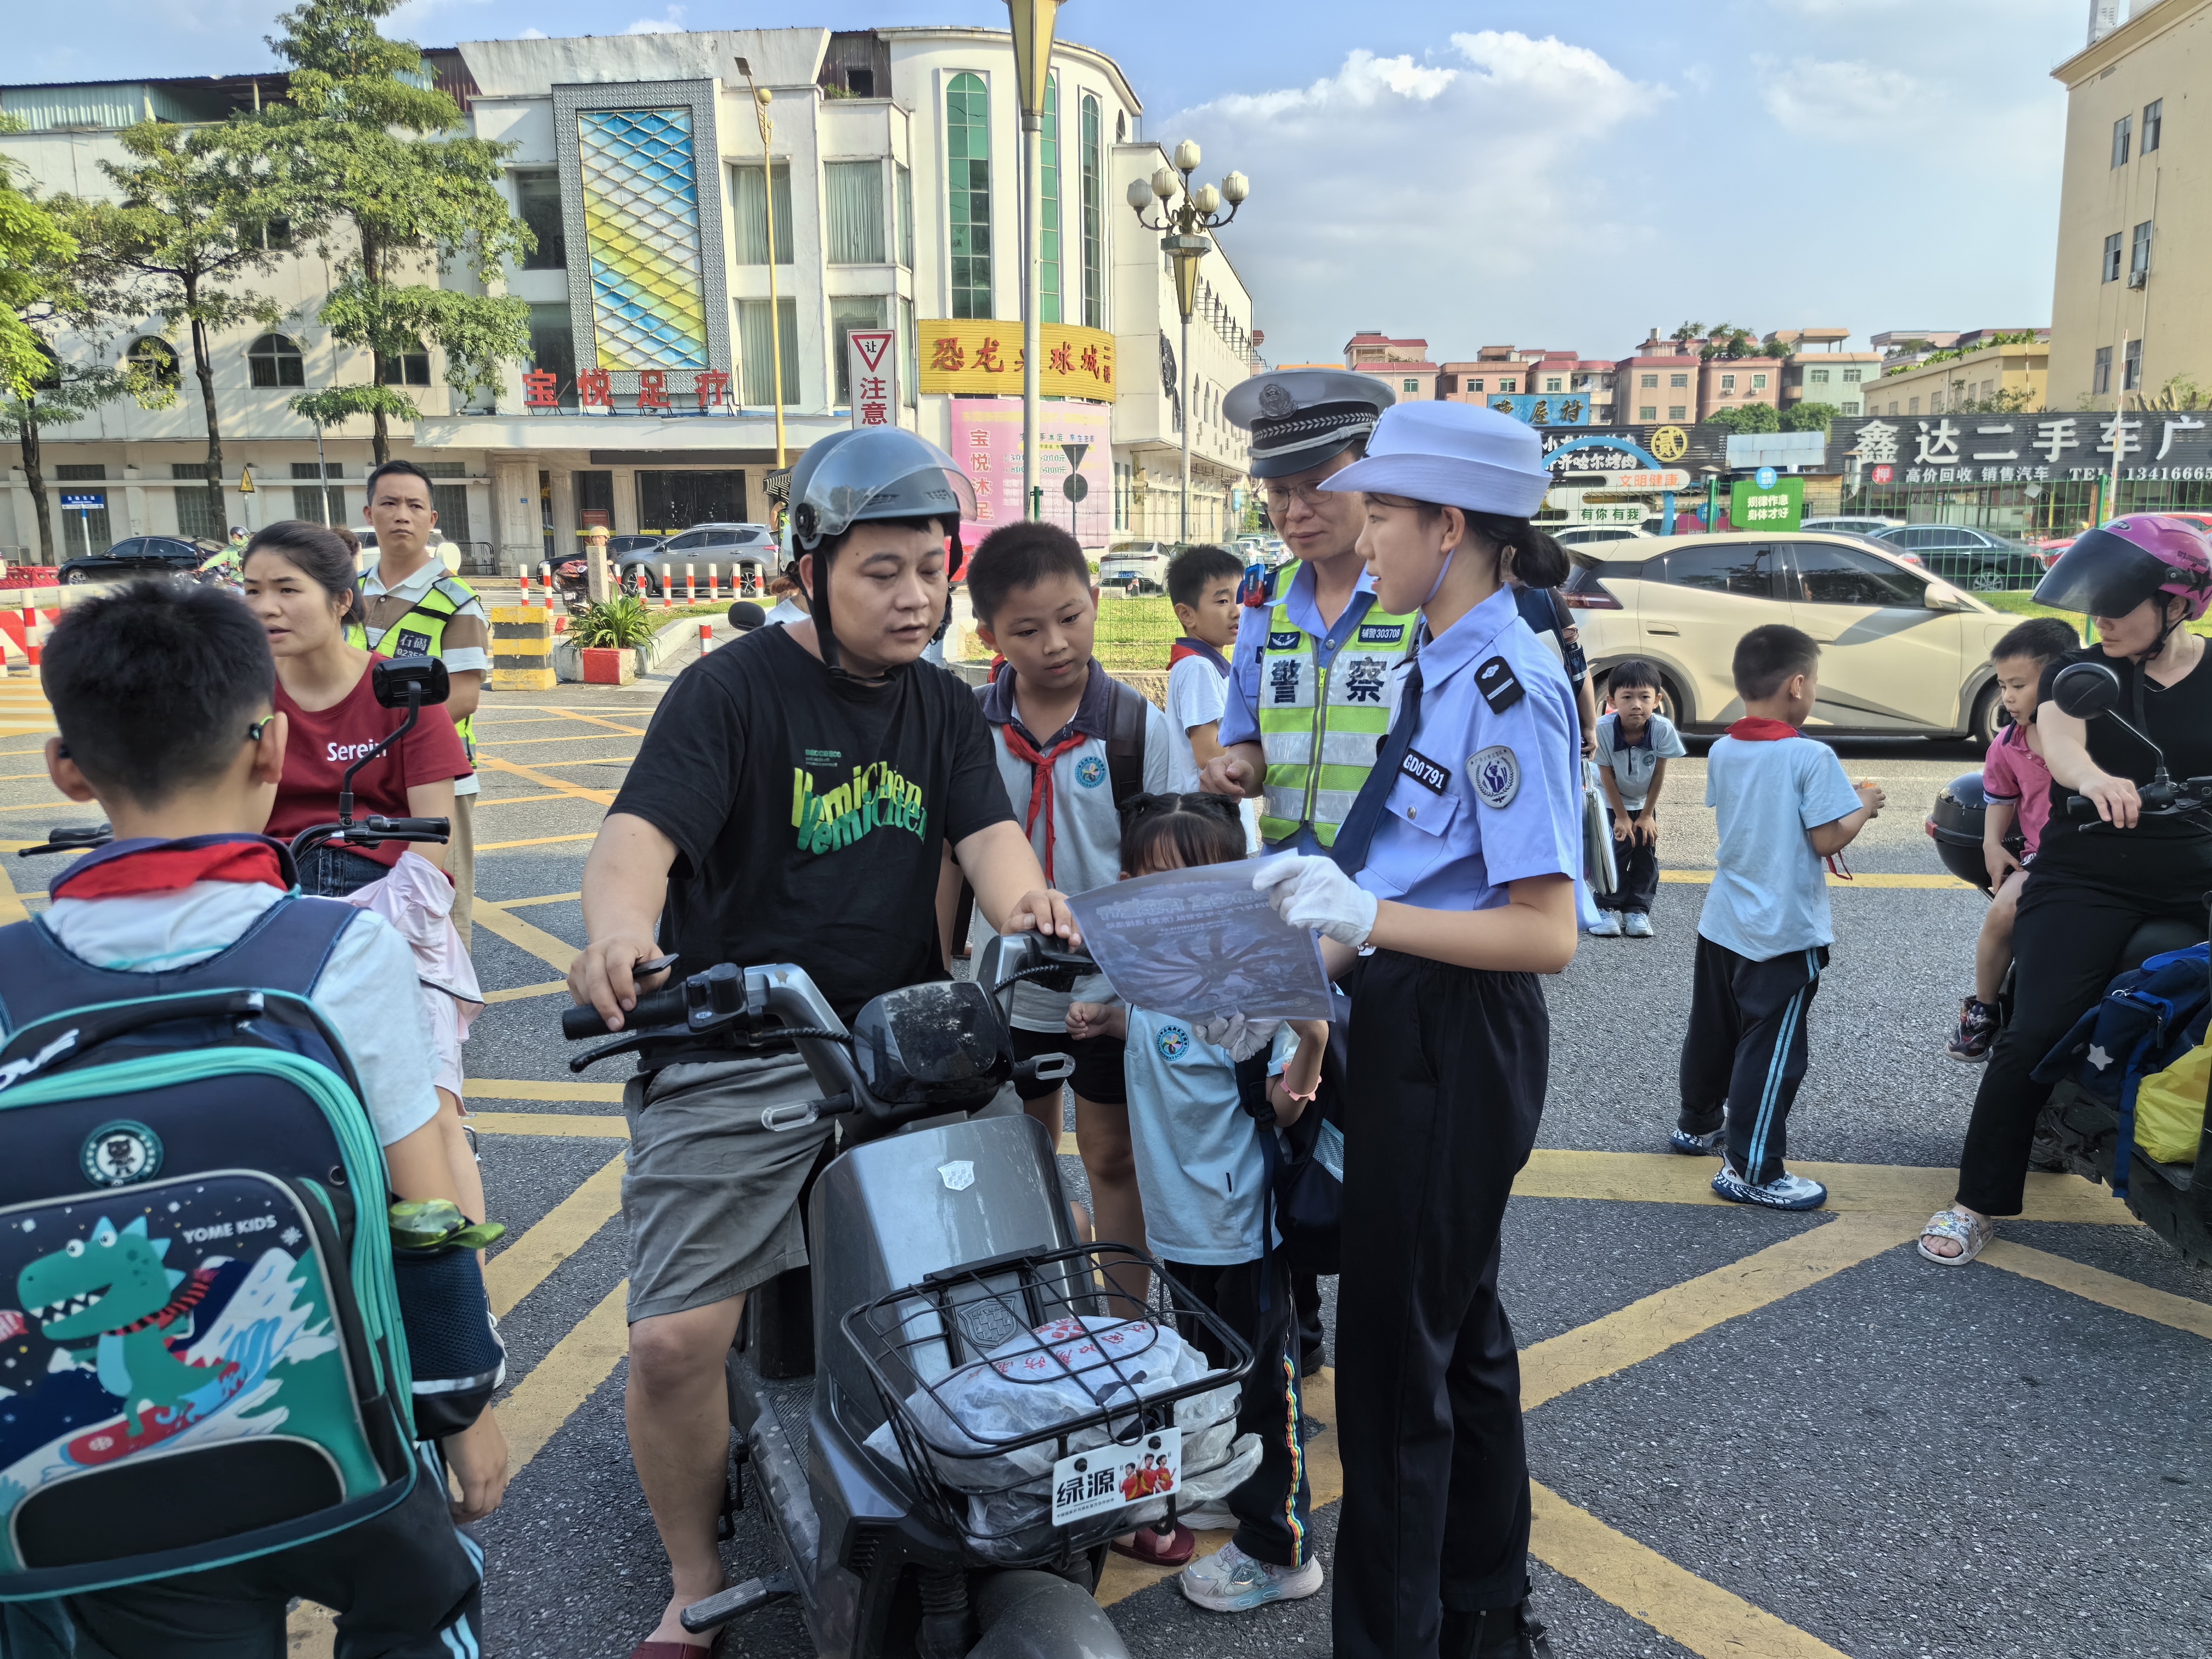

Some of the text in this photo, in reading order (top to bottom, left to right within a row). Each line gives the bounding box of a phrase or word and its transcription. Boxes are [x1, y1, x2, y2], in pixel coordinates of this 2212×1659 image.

[865, 341, 876, 354] 让
[522, 368, 730, 408] 宝悦足疗
[860, 376, 887, 425] 注意
[1656, 429, 1683, 457] 贰
[1853, 415, 2205, 465] 鑫达二手车广
[1619, 474, 1678, 488] 文明健康
[1875, 468, 1890, 482] 押
[1906, 466, 2049, 483] 高价回收 销售汽车
[1747, 494, 1789, 508] 规律作息
[1581, 508, 1640, 521] 有你 有我
[1747, 508, 1789, 521] 身体才好
[1270, 656, 1387, 703] 警察
[182, 1214, 278, 1244] YOME KIDS
[1056, 1467, 1115, 1508] 绿源
